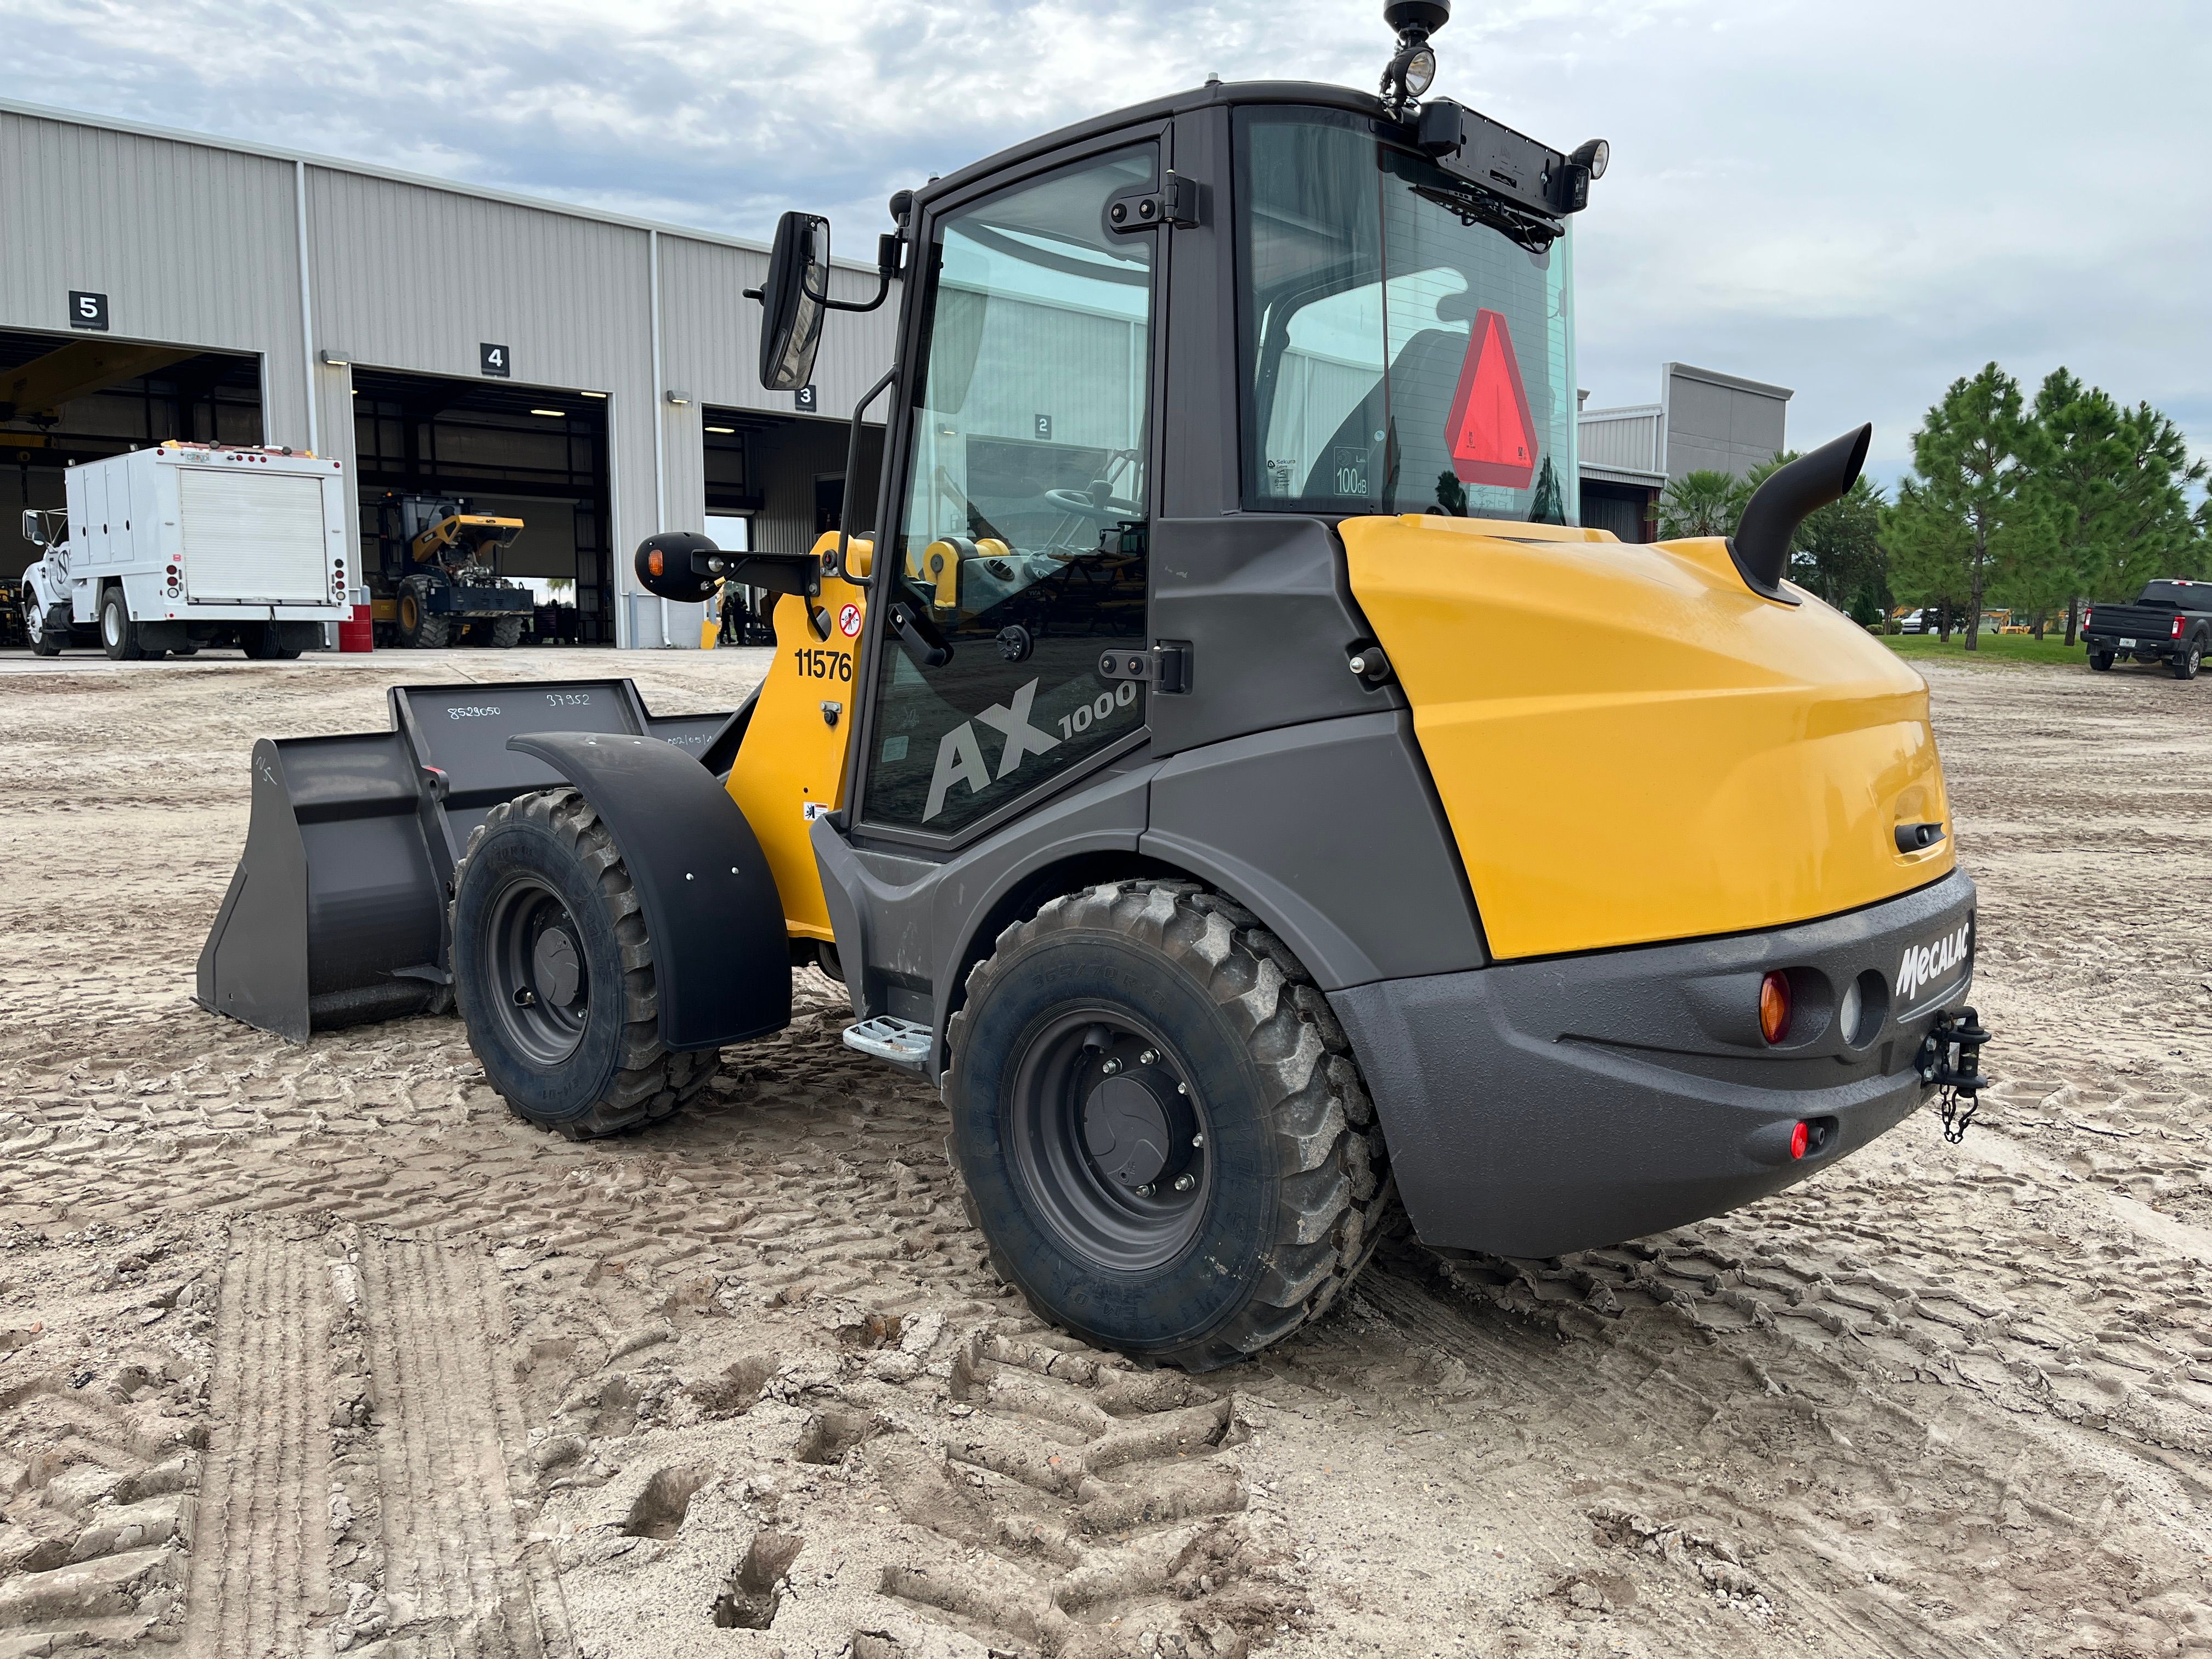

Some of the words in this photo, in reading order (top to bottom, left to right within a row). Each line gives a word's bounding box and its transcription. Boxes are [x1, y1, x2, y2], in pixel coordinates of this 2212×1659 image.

[80, 297, 98, 318] 5
[488, 349, 503, 366] 4
[800, 388, 811, 403] 3
[1039, 418, 1047, 432] 2
[794, 648, 852, 681] 11576
[546, 693, 592, 707] 37952
[447, 707, 501, 720] 8529050
[922, 676, 1062, 823] AX
[1058, 680, 1137, 741] 1000
[1031, 962, 1120, 990] 365/70
[1122, 973, 1138, 989] R
[1143, 983, 1167, 1008] 18
[1062, 1284, 1138, 1321] EM-01
